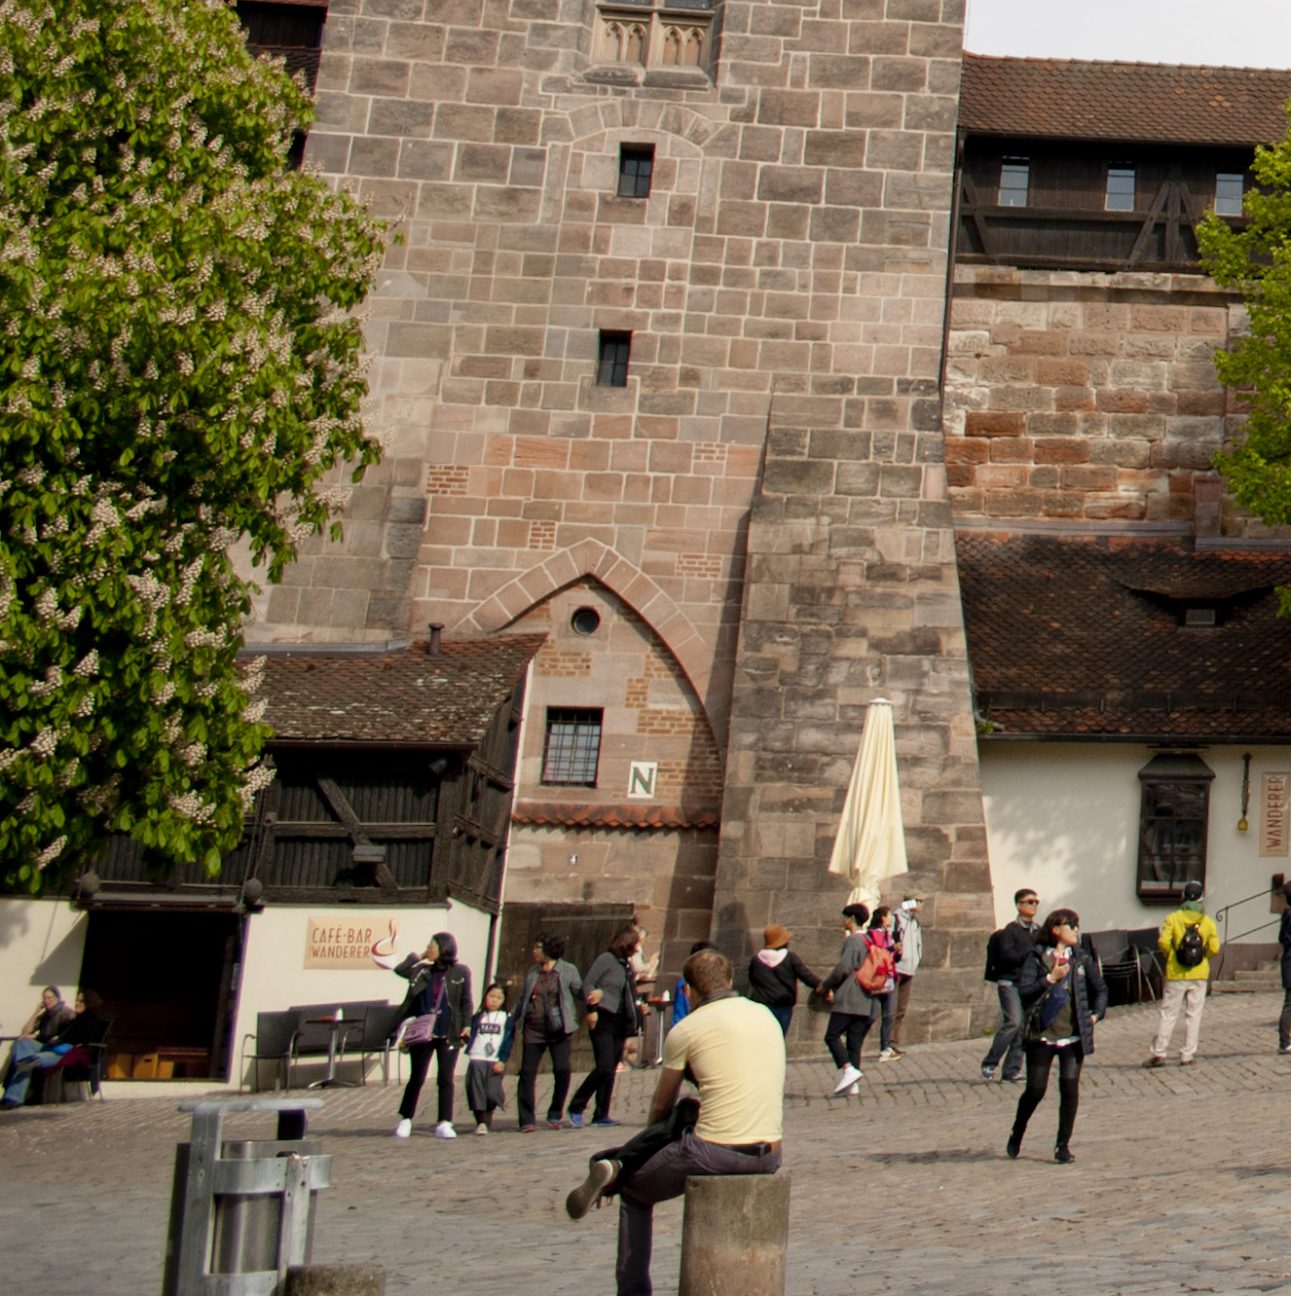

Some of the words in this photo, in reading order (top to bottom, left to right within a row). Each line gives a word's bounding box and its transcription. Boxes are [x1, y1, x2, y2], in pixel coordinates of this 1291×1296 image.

[629, 766, 655, 795] N
[1266, 776, 1284, 849] WANDERER
[312, 945, 370, 959] WANDERER
